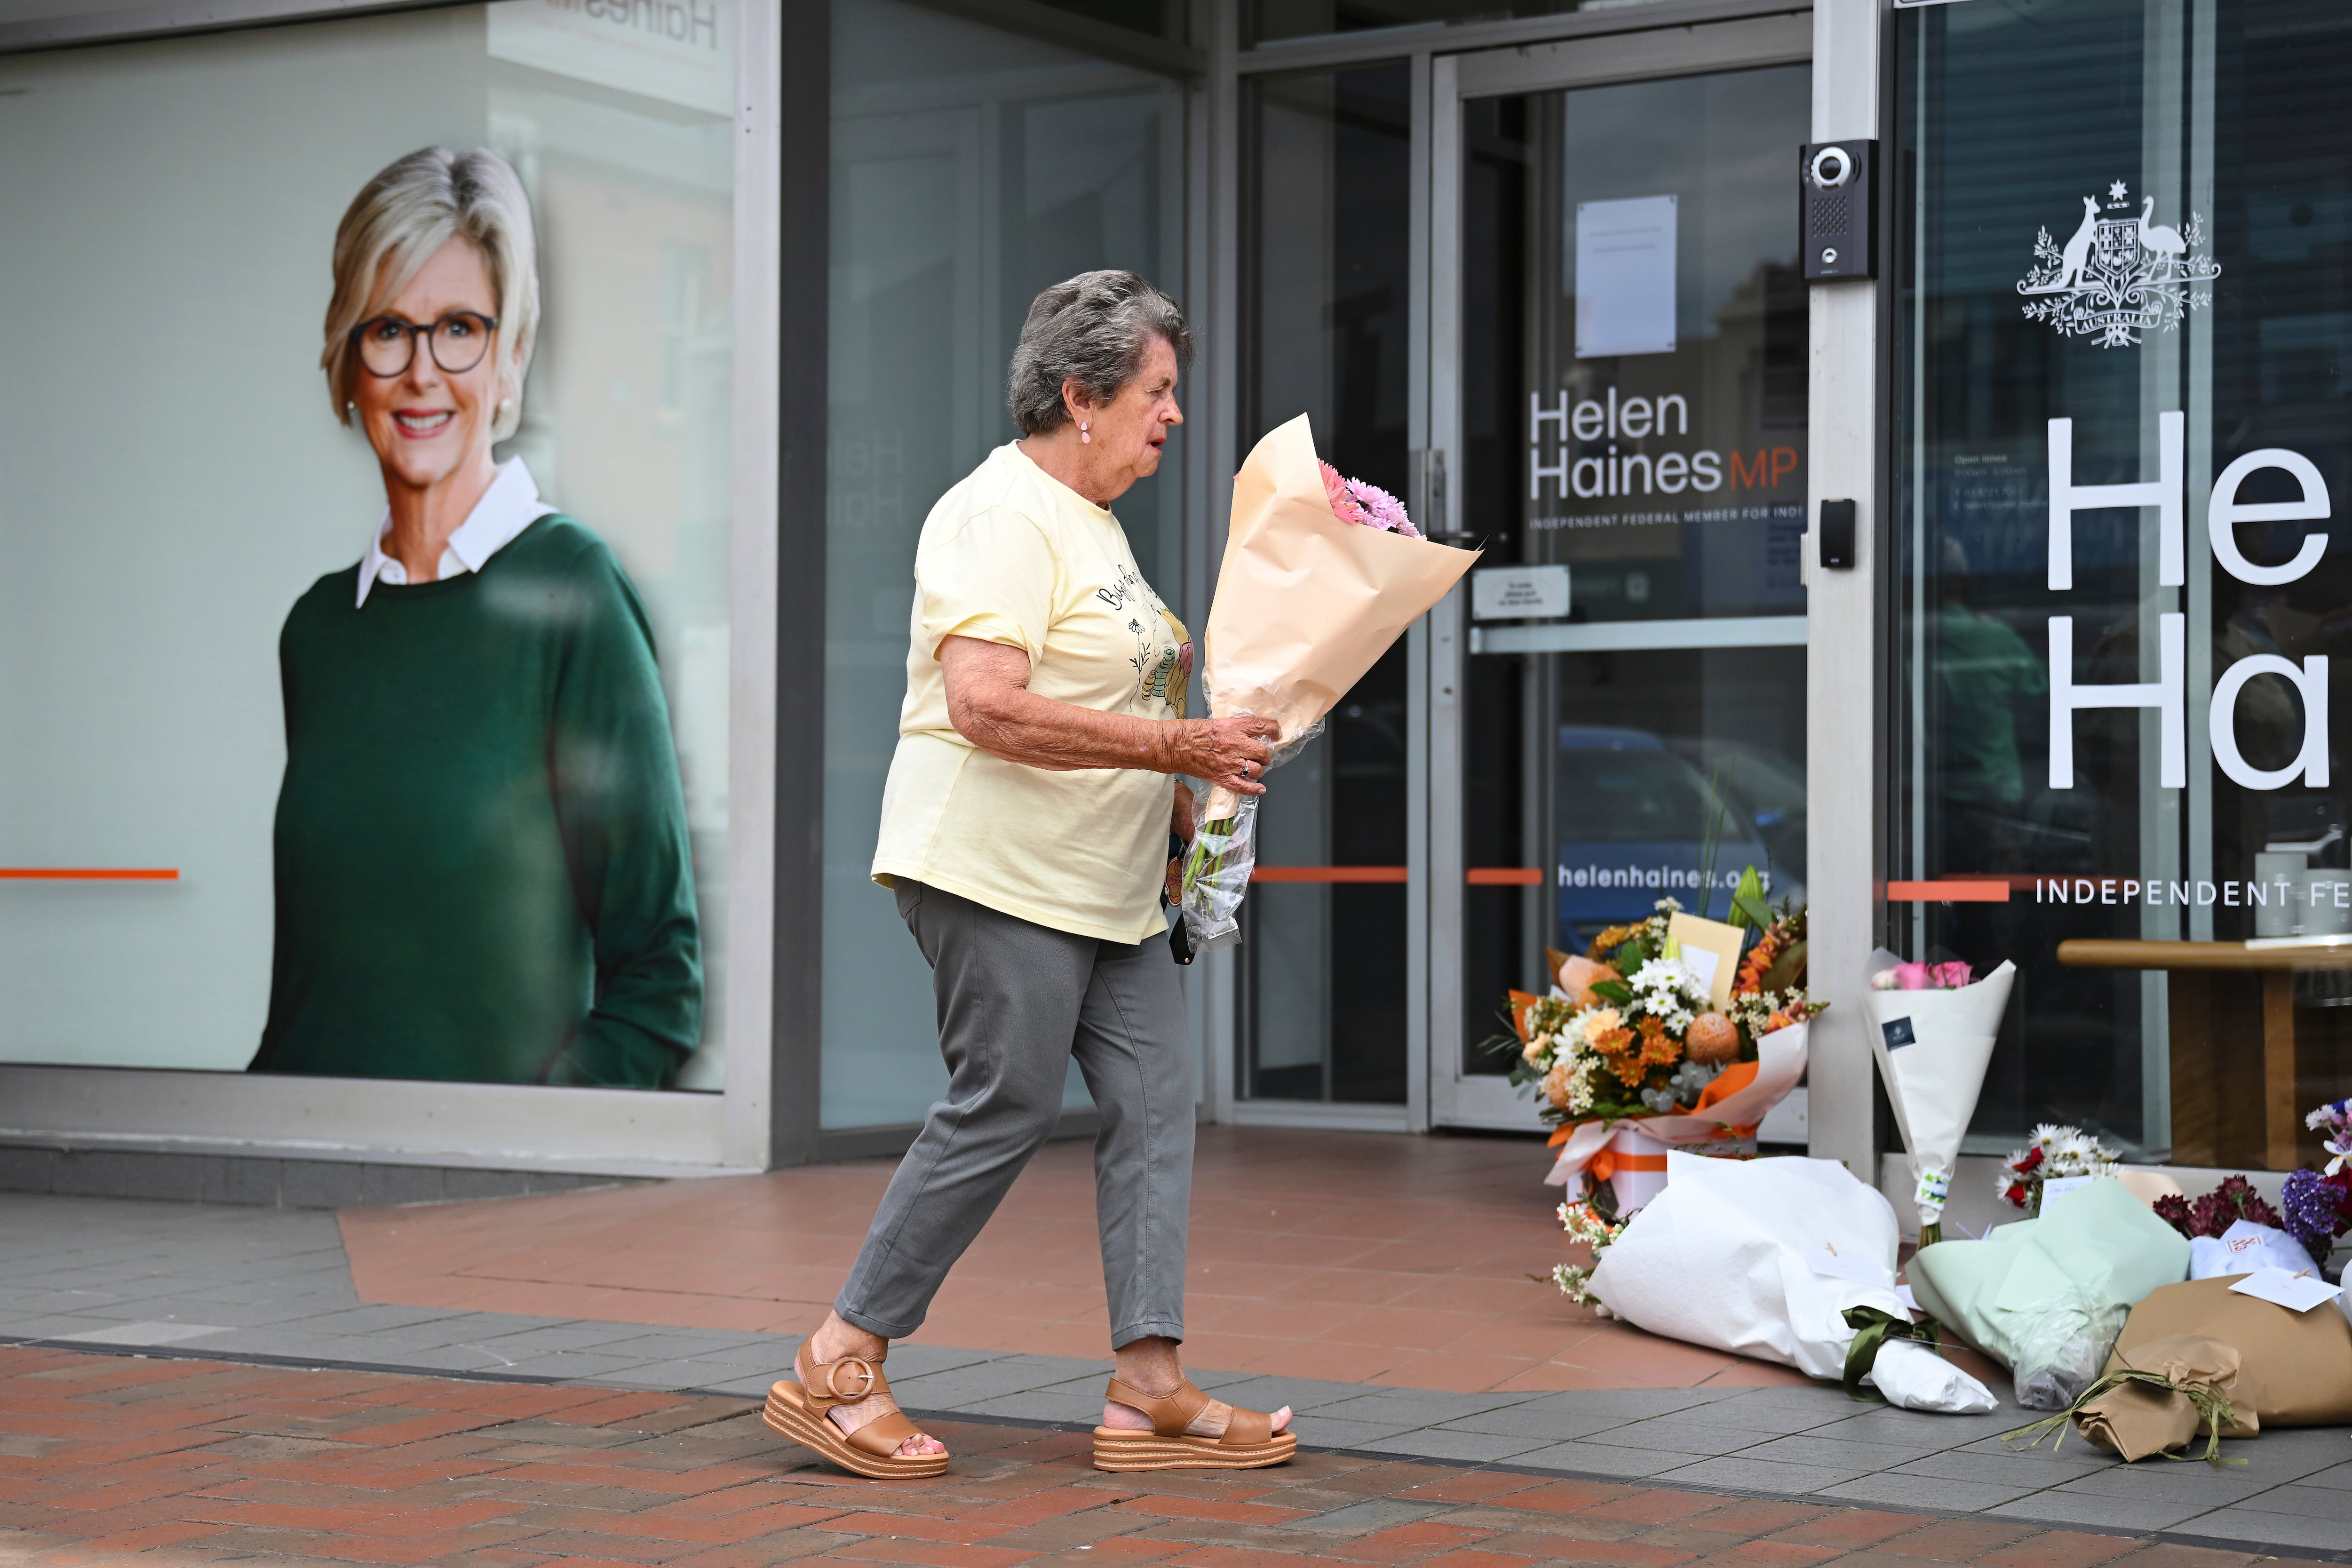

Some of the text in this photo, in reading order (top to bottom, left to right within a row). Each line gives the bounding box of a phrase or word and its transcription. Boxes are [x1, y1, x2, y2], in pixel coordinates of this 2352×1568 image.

[2081, 313, 2152, 331] AUSTRALIA
[1530, 386, 1687, 444] Helen
[1530, 445, 1798, 500] Haines MP
[1529, 505, 1803, 530] INDEPENDENT FEDERAL MEMBER FOR INDI
[2048, 411, 2331, 591] He
[2048, 612, 2330, 791] Ha
[2036, 879, 2350, 908] INDEPENDENT FE
